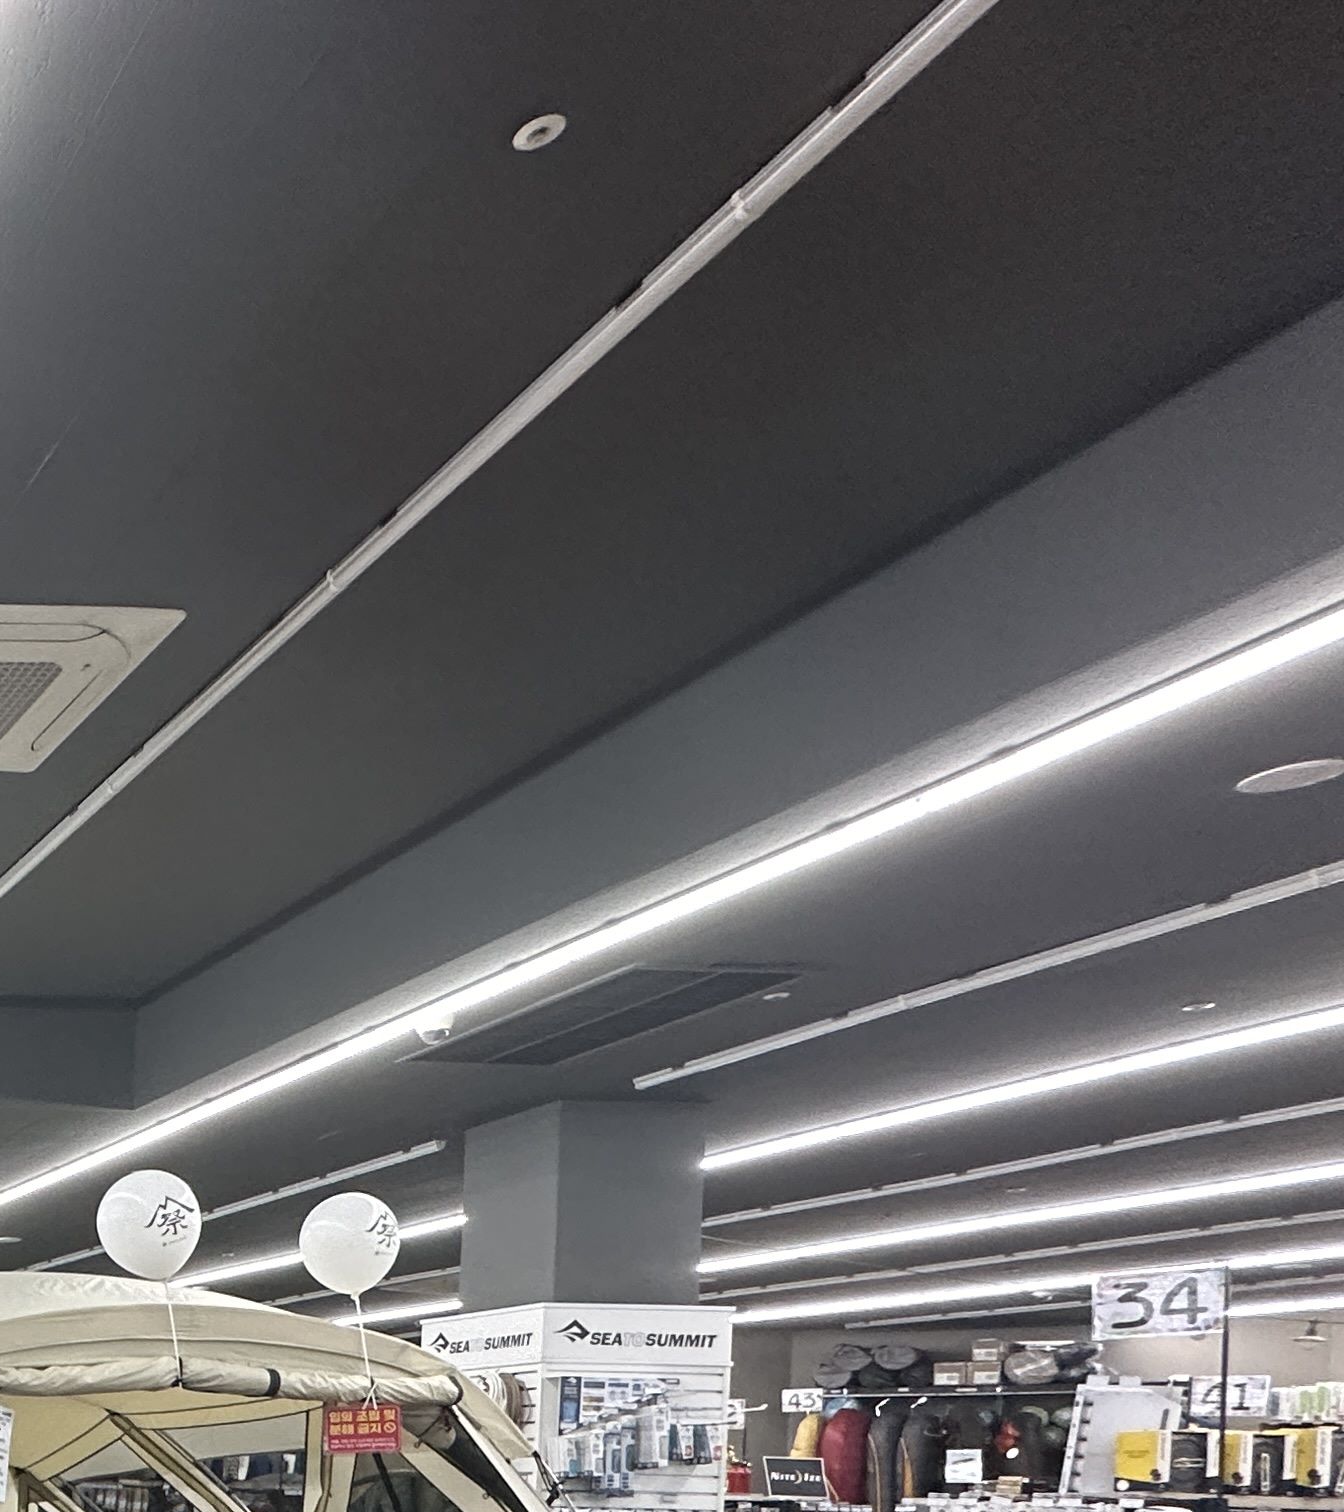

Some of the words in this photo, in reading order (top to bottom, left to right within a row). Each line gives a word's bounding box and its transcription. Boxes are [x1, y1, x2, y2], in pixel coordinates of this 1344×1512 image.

[1111, 1276, 1209, 1330] 34
[483, 1332, 533, 1351] SUMMIT
[589, 1332, 623, 1346] SEA
[644, 1332, 718, 1348] SUMMIT
[787, 1392, 817, 1410] 43
